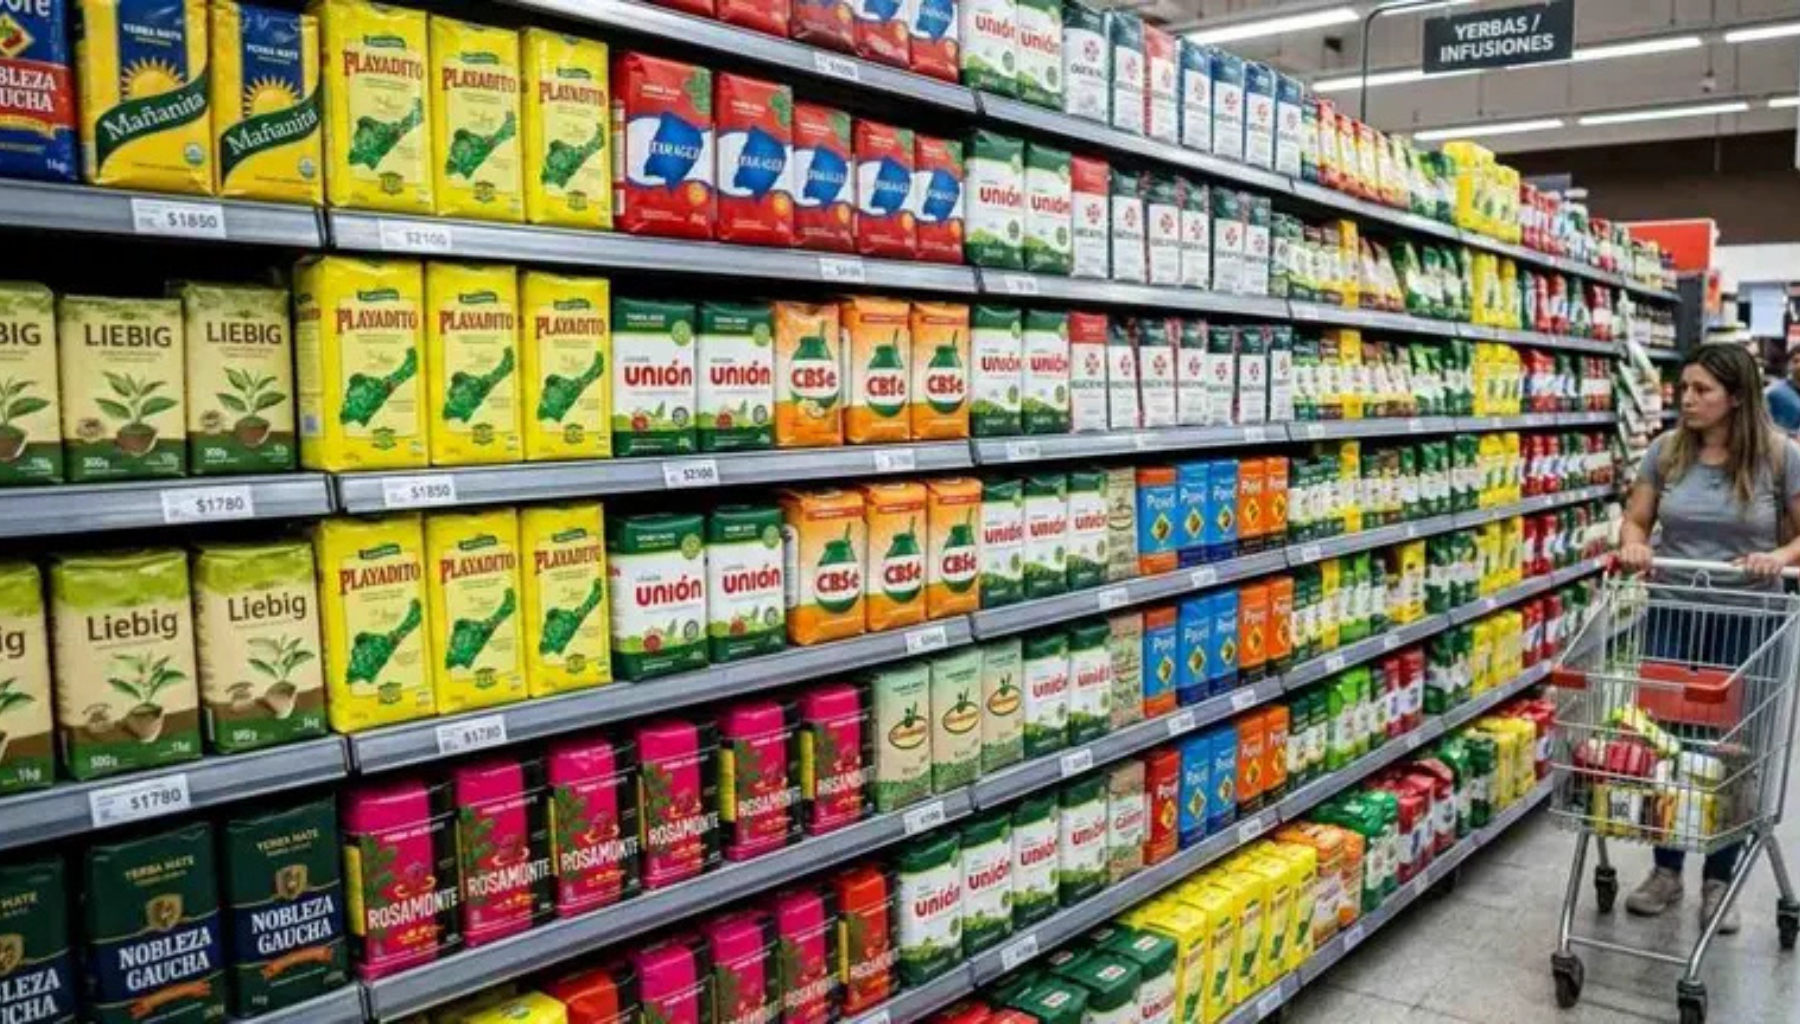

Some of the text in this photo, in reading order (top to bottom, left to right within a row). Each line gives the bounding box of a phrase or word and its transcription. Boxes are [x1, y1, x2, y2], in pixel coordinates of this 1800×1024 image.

[1455, 14, 1542, 40] YERBAS /
[1440, 33, 1554, 62] INFUSIONES
[343, 50, 424, 79] PLAYADITO
[441, 67, 517, 92] PLAYADITO
[102, 90, 206, 141] Mañanita
[224, 107, 318, 155] Mañanita
[166, 212, 218, 229] $1850
[85, 323, 172, 347] LIEBIG
[206, 321, 281, 344] LIEBIG
[336, 307, 418, 334] PLAYADITO
[440, 309, 514, 335] PLAYADITO
[536, 315, 605, 340] PLAYADITO
[625, 360, 692, 386] unión
[711, 360, 771, 385] unión
[196, 496, 243, 513] $1780
[411, 484, 450, 499] $1850
[440, 552, 515, 584] PLAYADITO
[534, 544, 601, 575] PLAYADITO
[339, 560, 421, 596] PLAYADITO
[636, 575, 702, 607] unión
[722, 563, 780, 594] unión
[228, 592, 307, 623] Liebig
[87, 608, 179, 642] Liebig
[130, 788, 182, 811] $1780
[560, 835, 639, 873] ROSAMONTE
[466, 857, 550, 899] ROSAMONTE
[251, 894, 334, 935] NOBLEZA
[367, 885, 457, 931] ROSAMONTE
[118, 926, 212, 971] NOBLEZA
[257, 917, 333, 954] GAUCHA
[126, 950, 211, 992] GAUCHA
